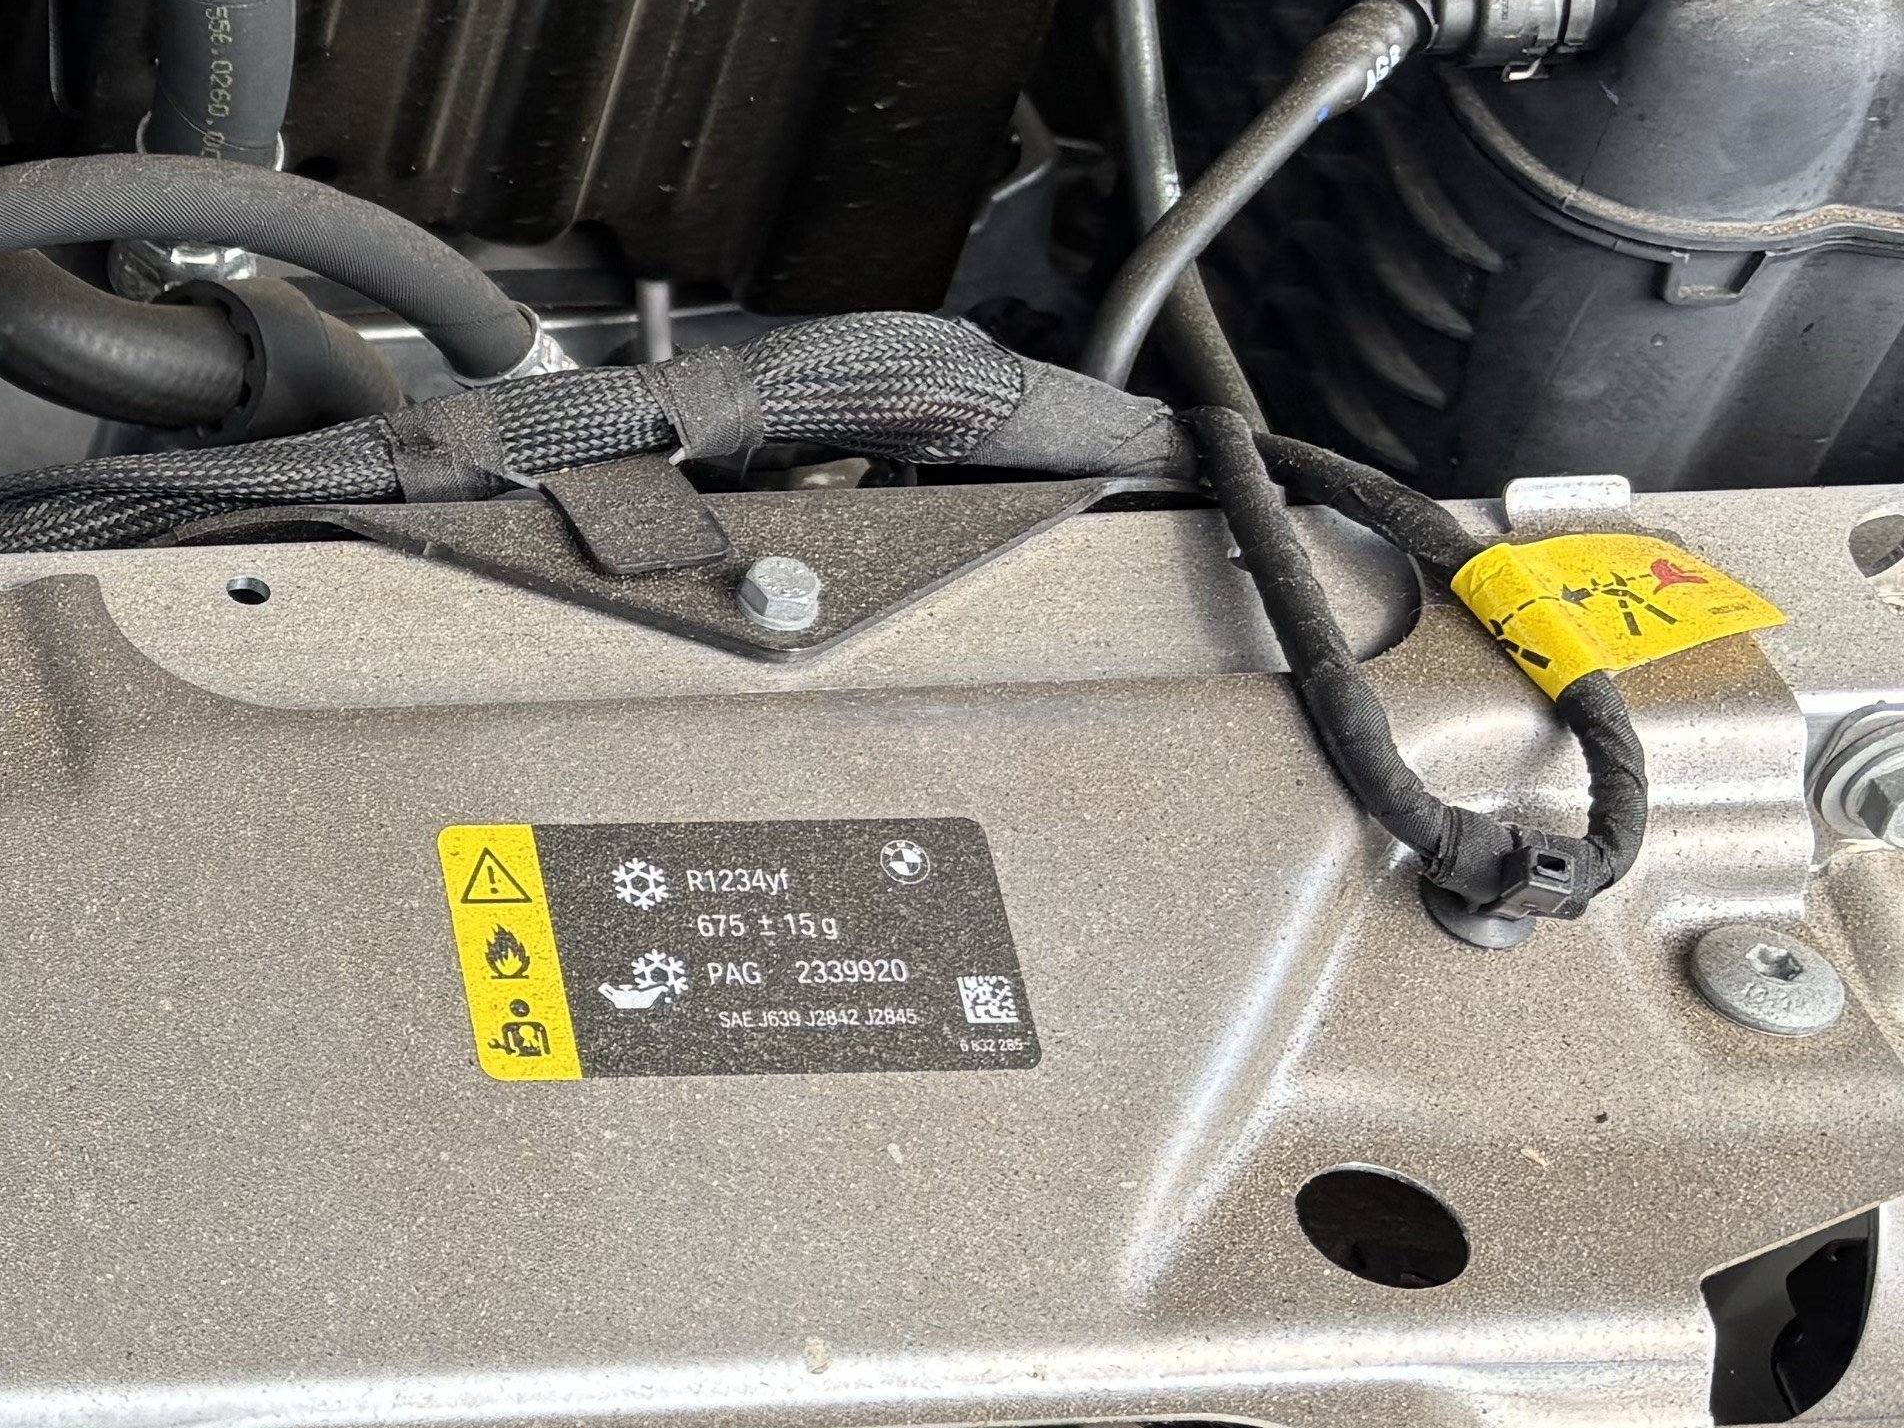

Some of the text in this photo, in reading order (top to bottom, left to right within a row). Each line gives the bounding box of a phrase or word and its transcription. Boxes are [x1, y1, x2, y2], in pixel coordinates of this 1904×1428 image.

[685, 867, 789, 896] R1234yf
[696, 913, 839, 940] 675 ± 15 g
[706, 958, 908, 986] PAG 2339920
[718, 1008, 918, 1029] SAE J639 J2842 J2845
